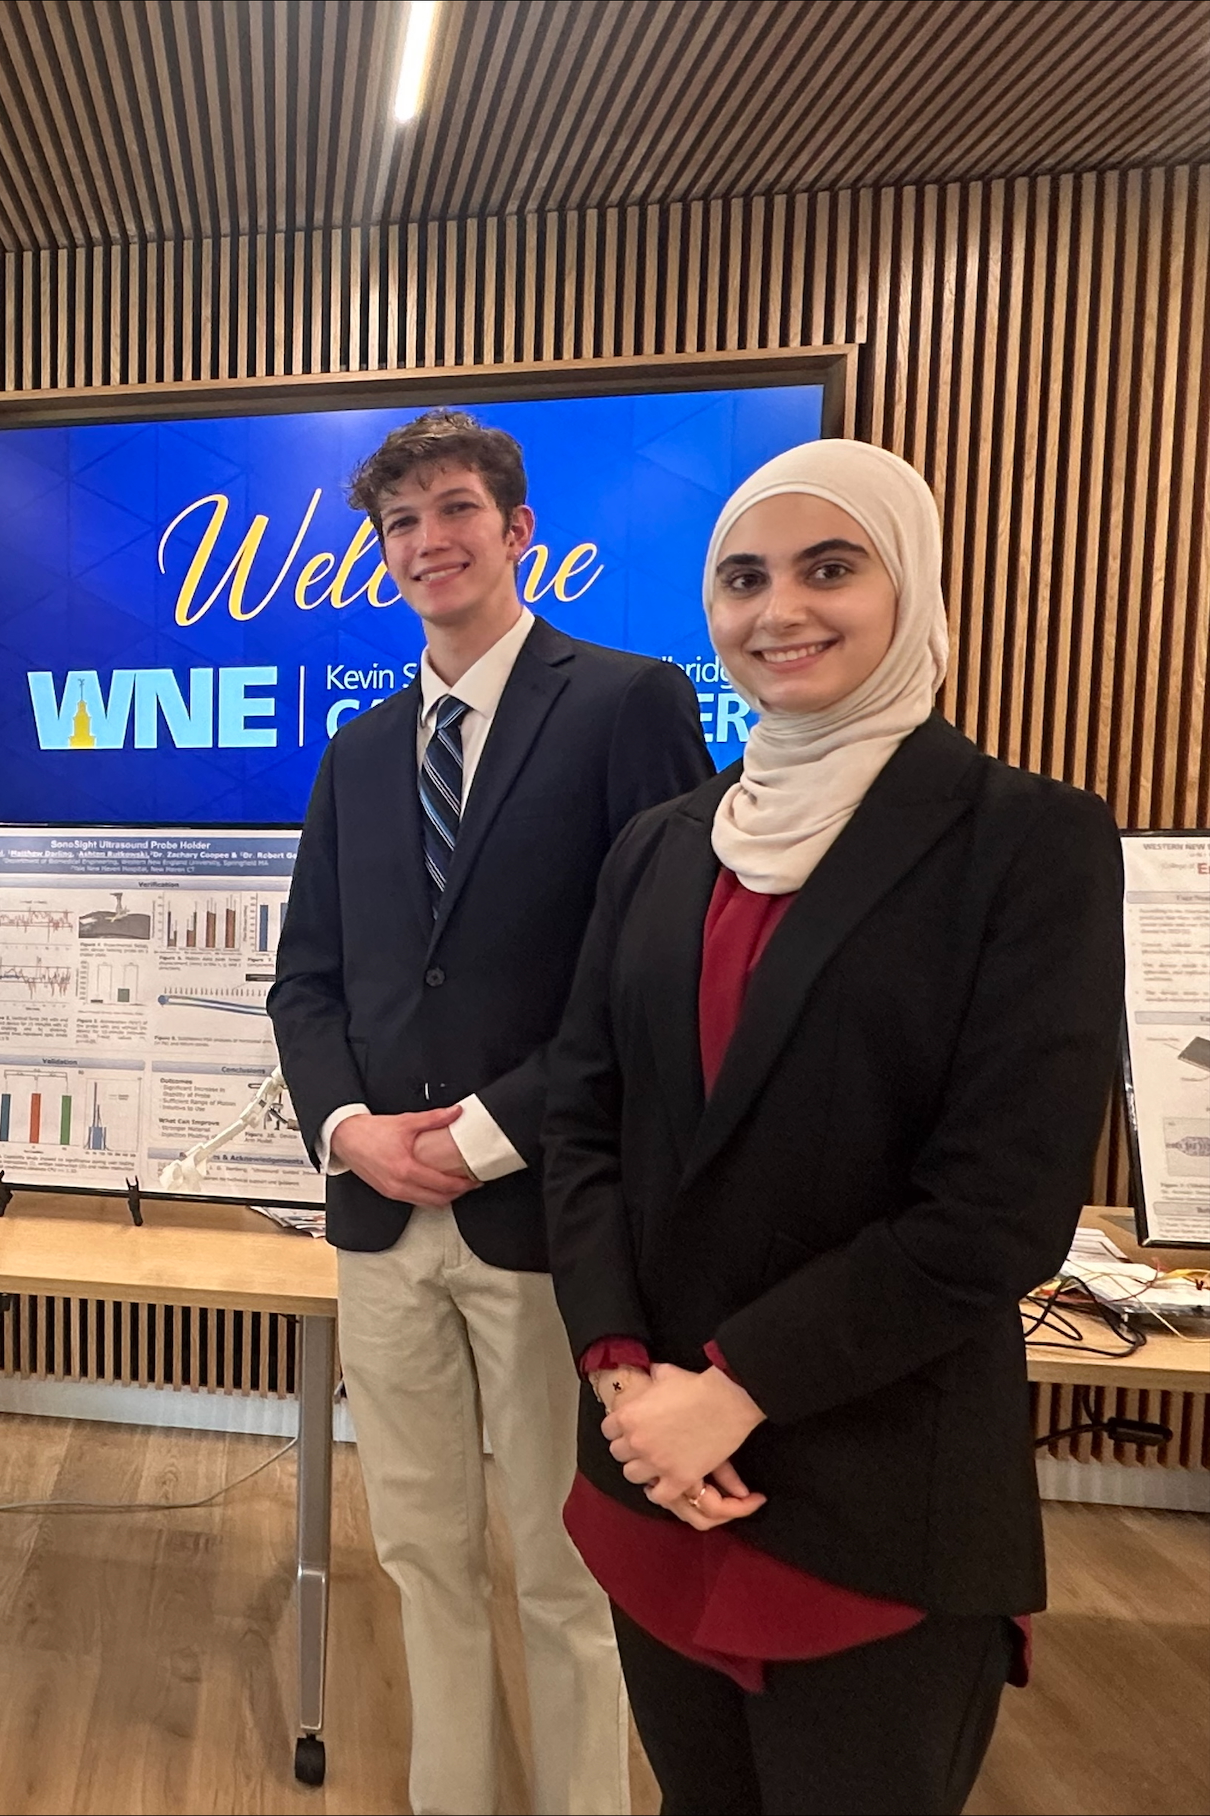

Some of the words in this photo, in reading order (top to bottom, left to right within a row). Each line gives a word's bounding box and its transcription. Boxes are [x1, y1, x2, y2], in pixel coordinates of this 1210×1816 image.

[326, 662, 395, 690] Kevin
[27, 667, 278, 750] WNE
[50, 840, 97, 850] SonoSight
[99, 840, 149, 849] Ultrasound
[150, 841, 178, 850] Probe
[180, 841, 211, 850] Holder
[167, 851, 198, 860] Zachary
[42, 1058, 78, 1066] Validation
[221, 1066, 266, 1074] Conclusions
[163, 1097, 189, 1105] Sufficient
[190, 1099, 208, 1107] Range
[191, 1119, 220, 1127] Improve
[230, 1155, 304, 1165] Acknowledgements
